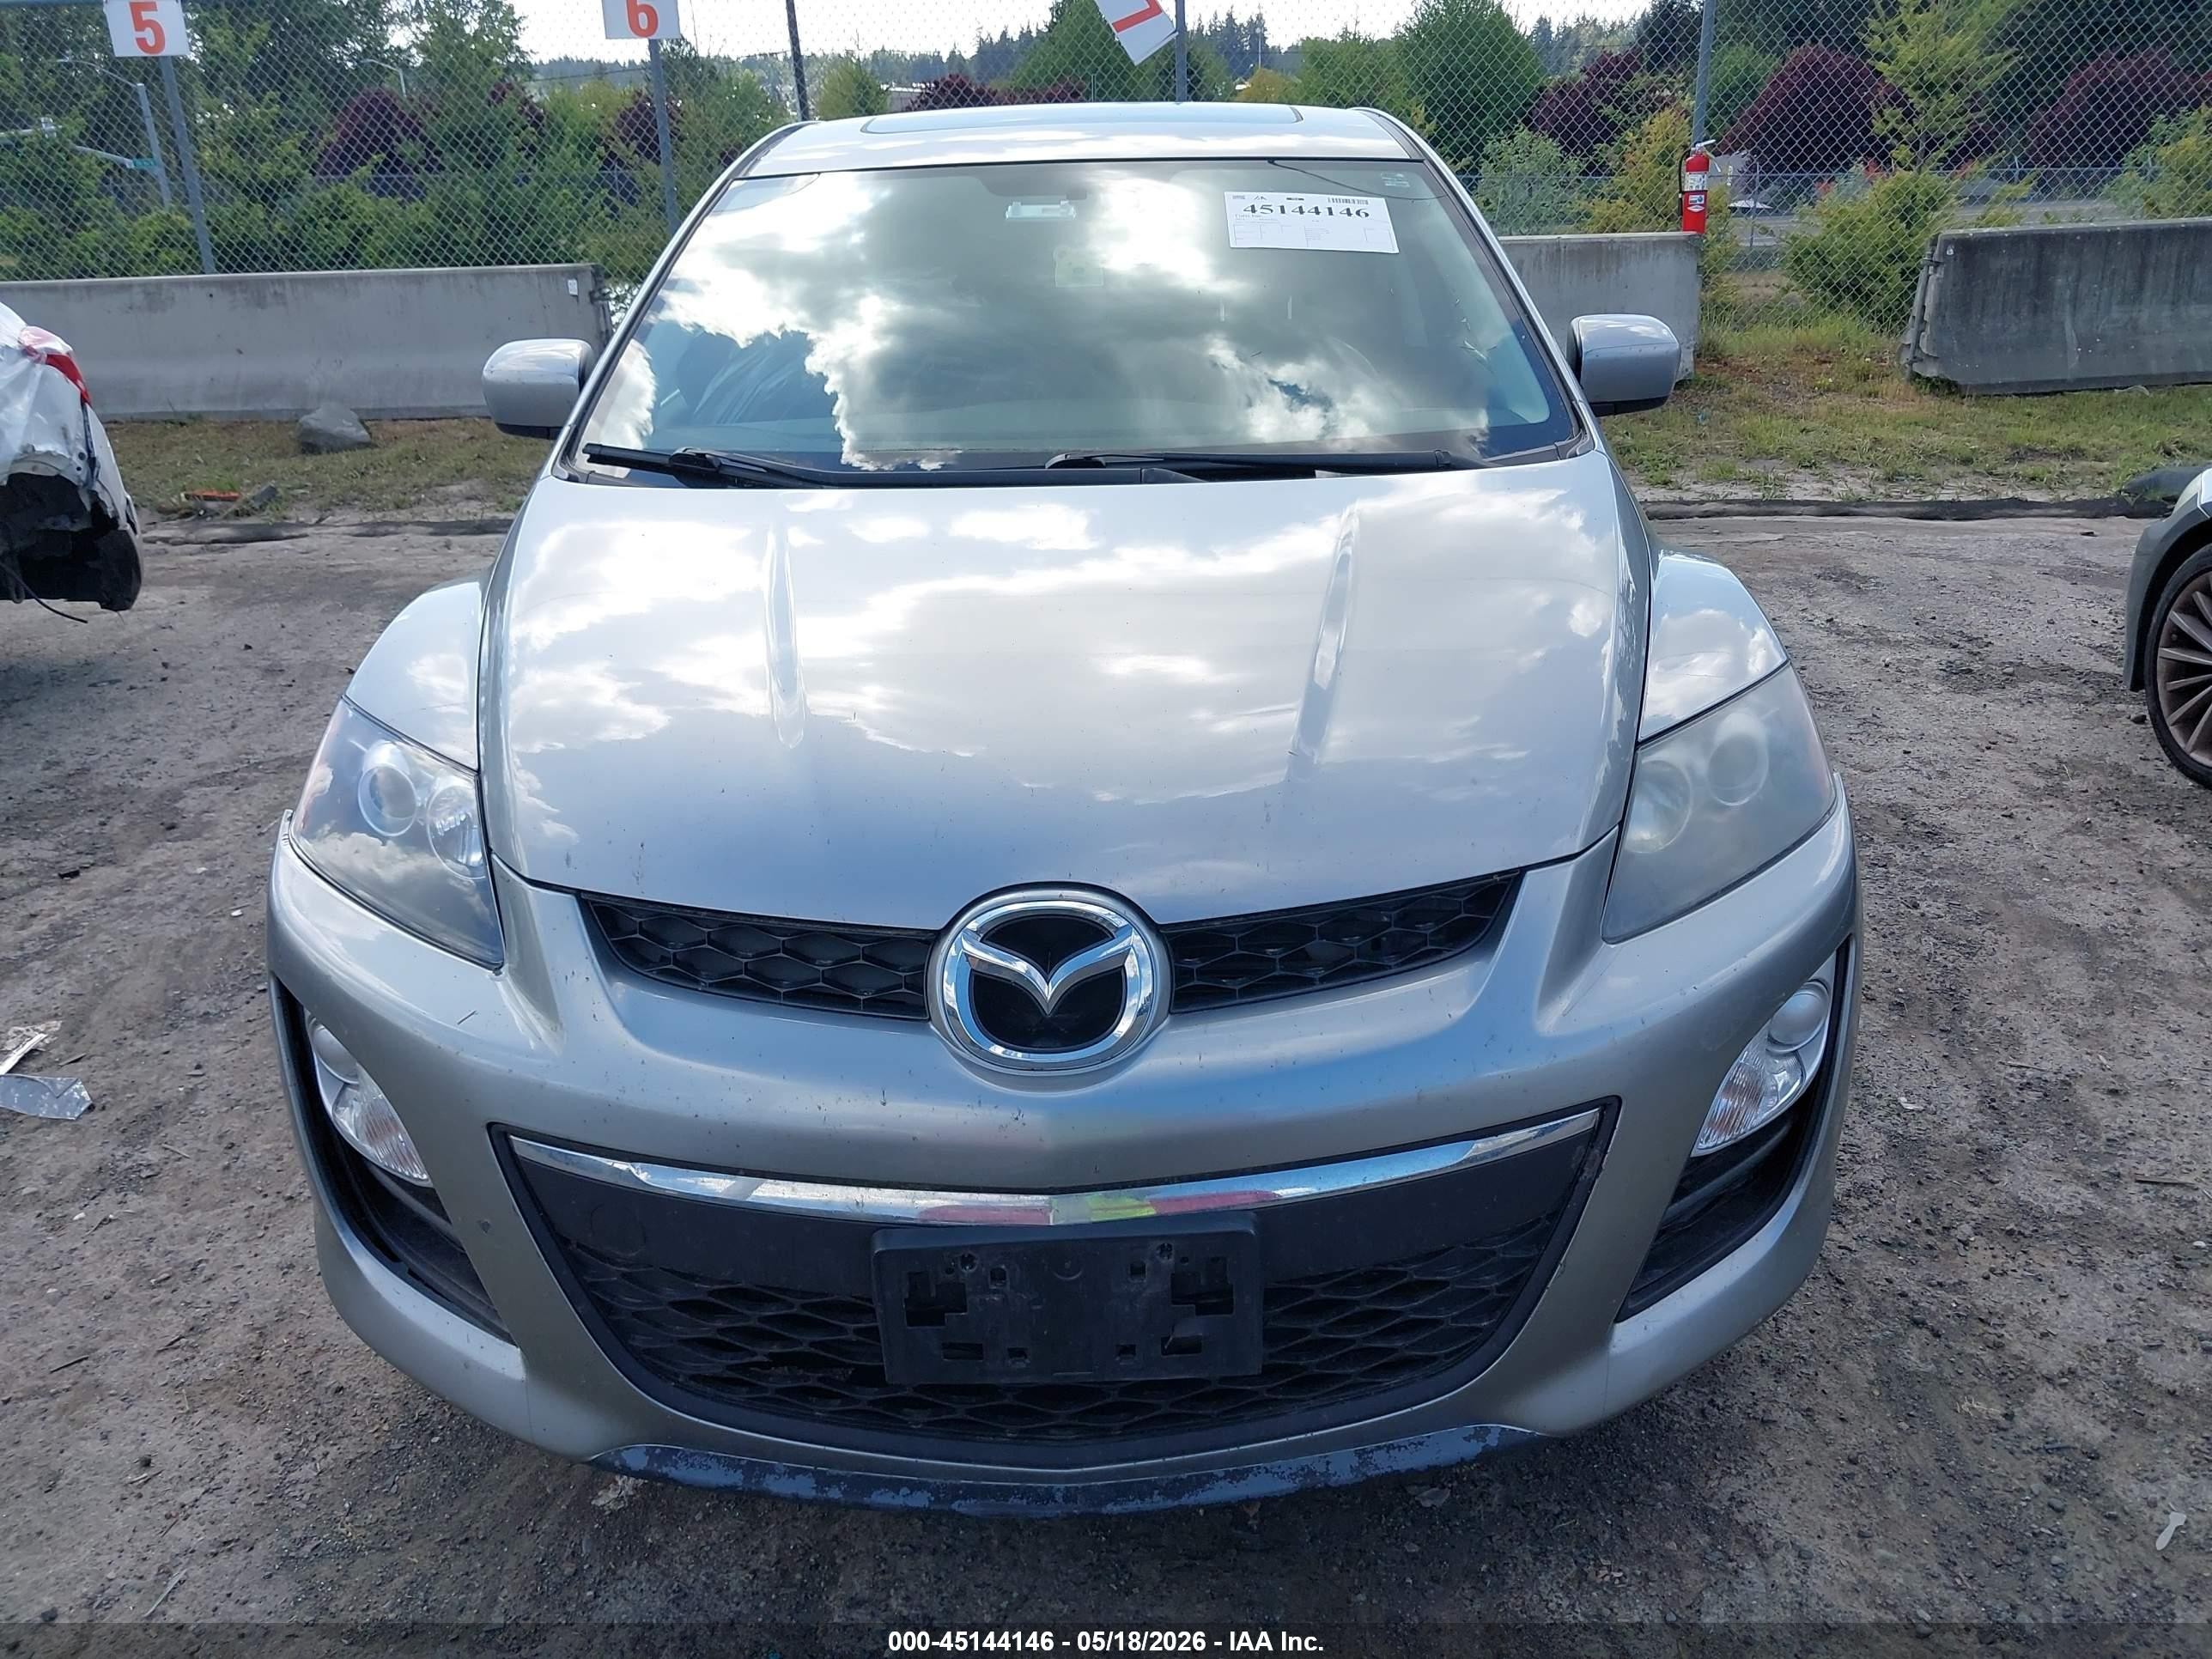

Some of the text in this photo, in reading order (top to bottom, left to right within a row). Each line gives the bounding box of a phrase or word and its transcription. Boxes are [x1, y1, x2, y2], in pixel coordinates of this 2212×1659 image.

[129, 2, 166, 55] 5
[626, 0, 659, 38] 6
[1243, 204, 1370, 219] 45144146
